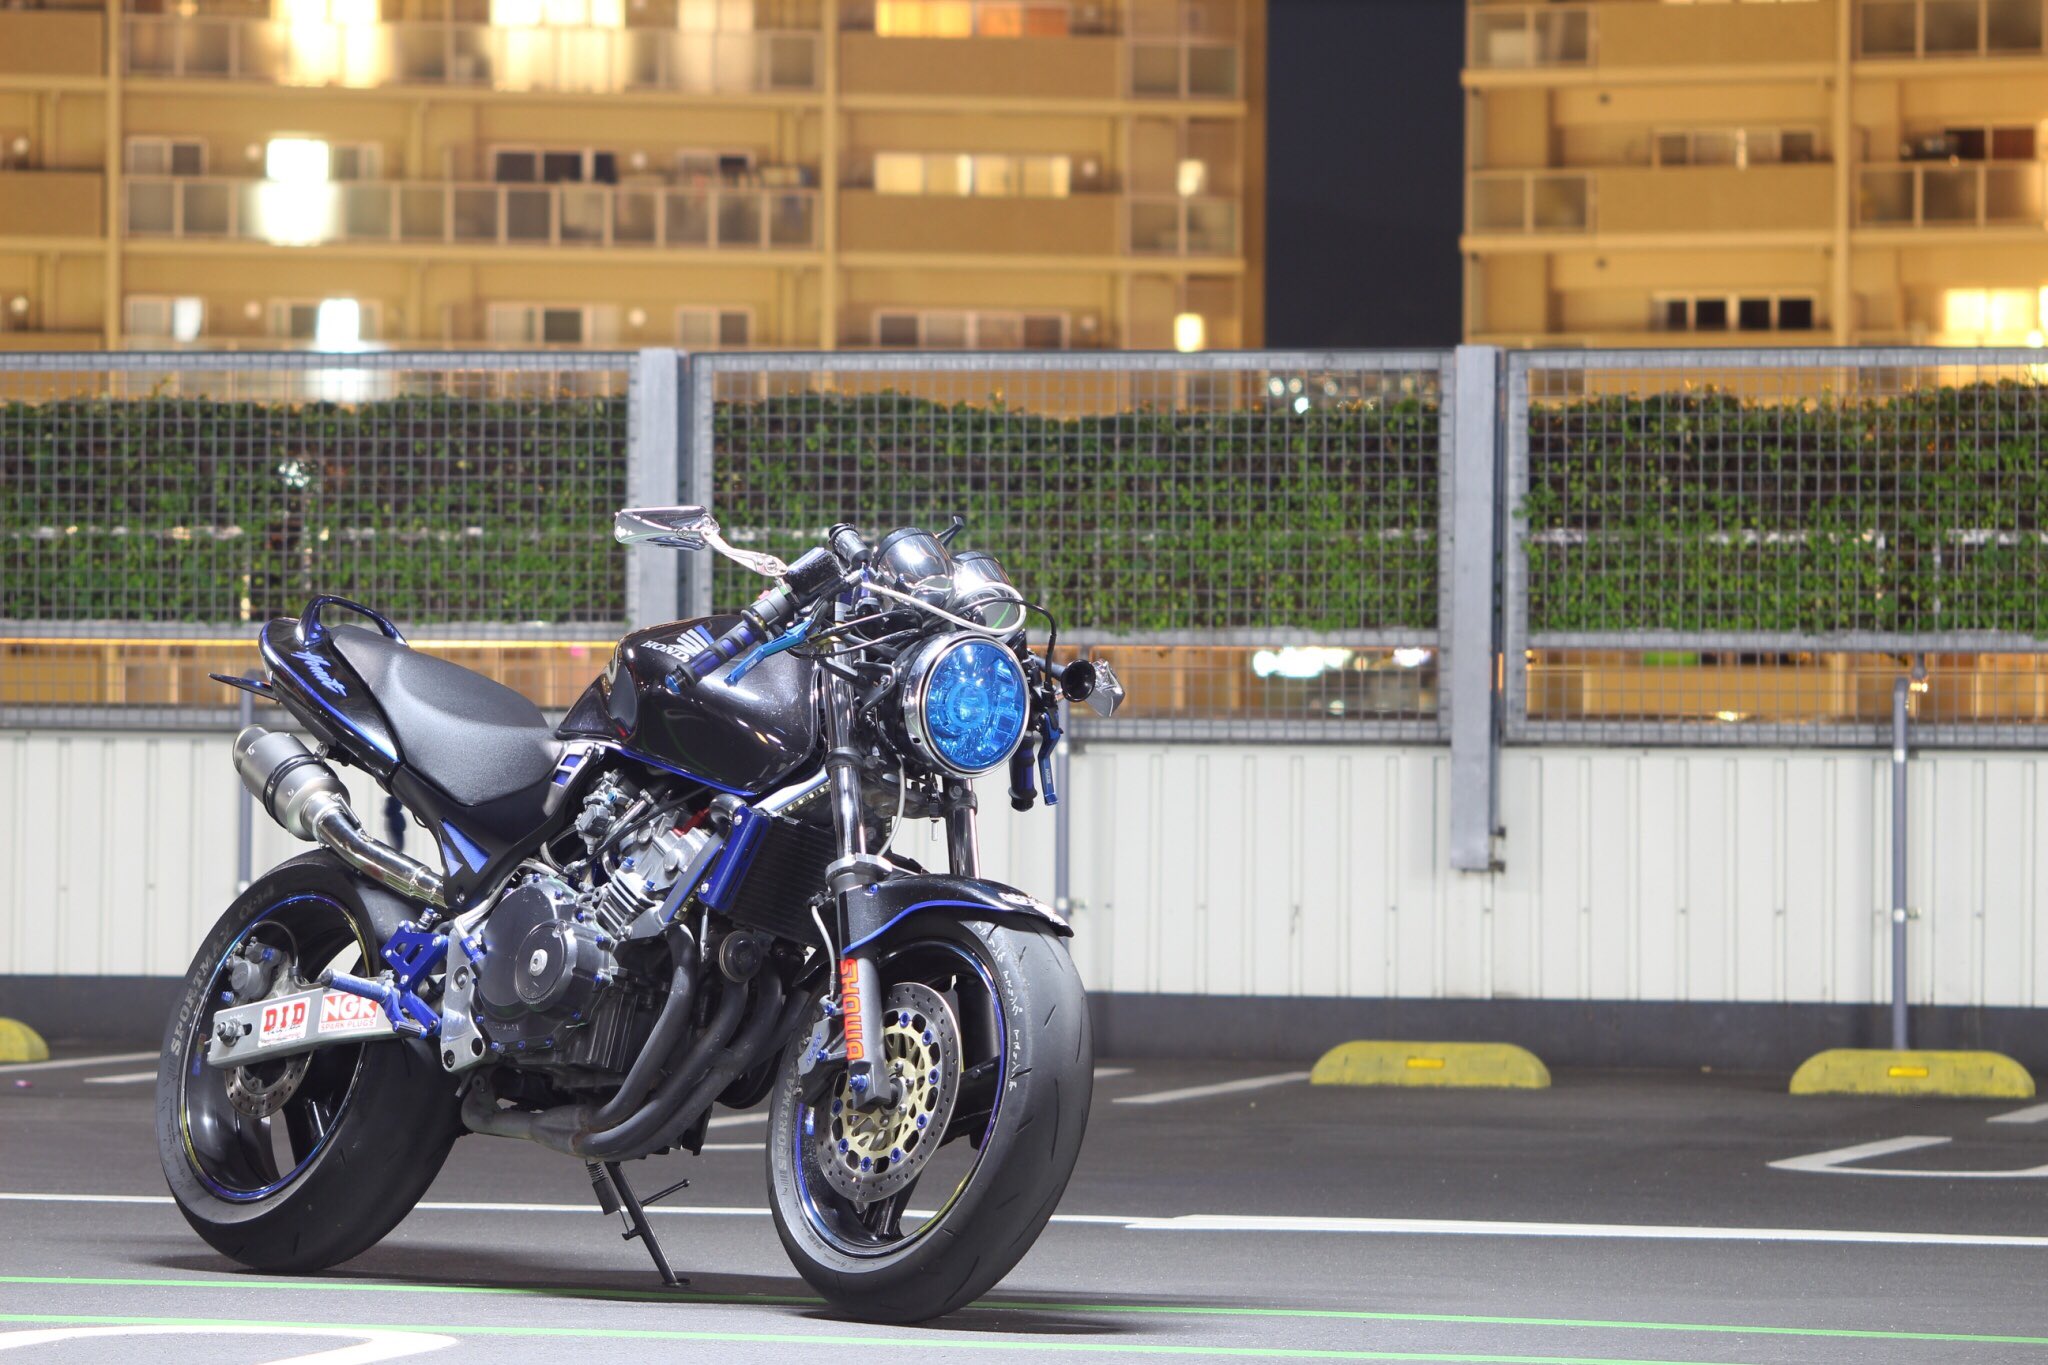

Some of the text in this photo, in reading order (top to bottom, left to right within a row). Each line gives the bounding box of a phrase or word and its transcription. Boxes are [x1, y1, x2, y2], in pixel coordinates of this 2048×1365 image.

[641, 640, 690, 663] HOND
[263, 1002, 306, 1033] DID
[321, 993, 377, 1022] NGK
[840, 958, 865, 1061] SHOWA
[320, 1018, 376, 1031] SPARK PLUGS
